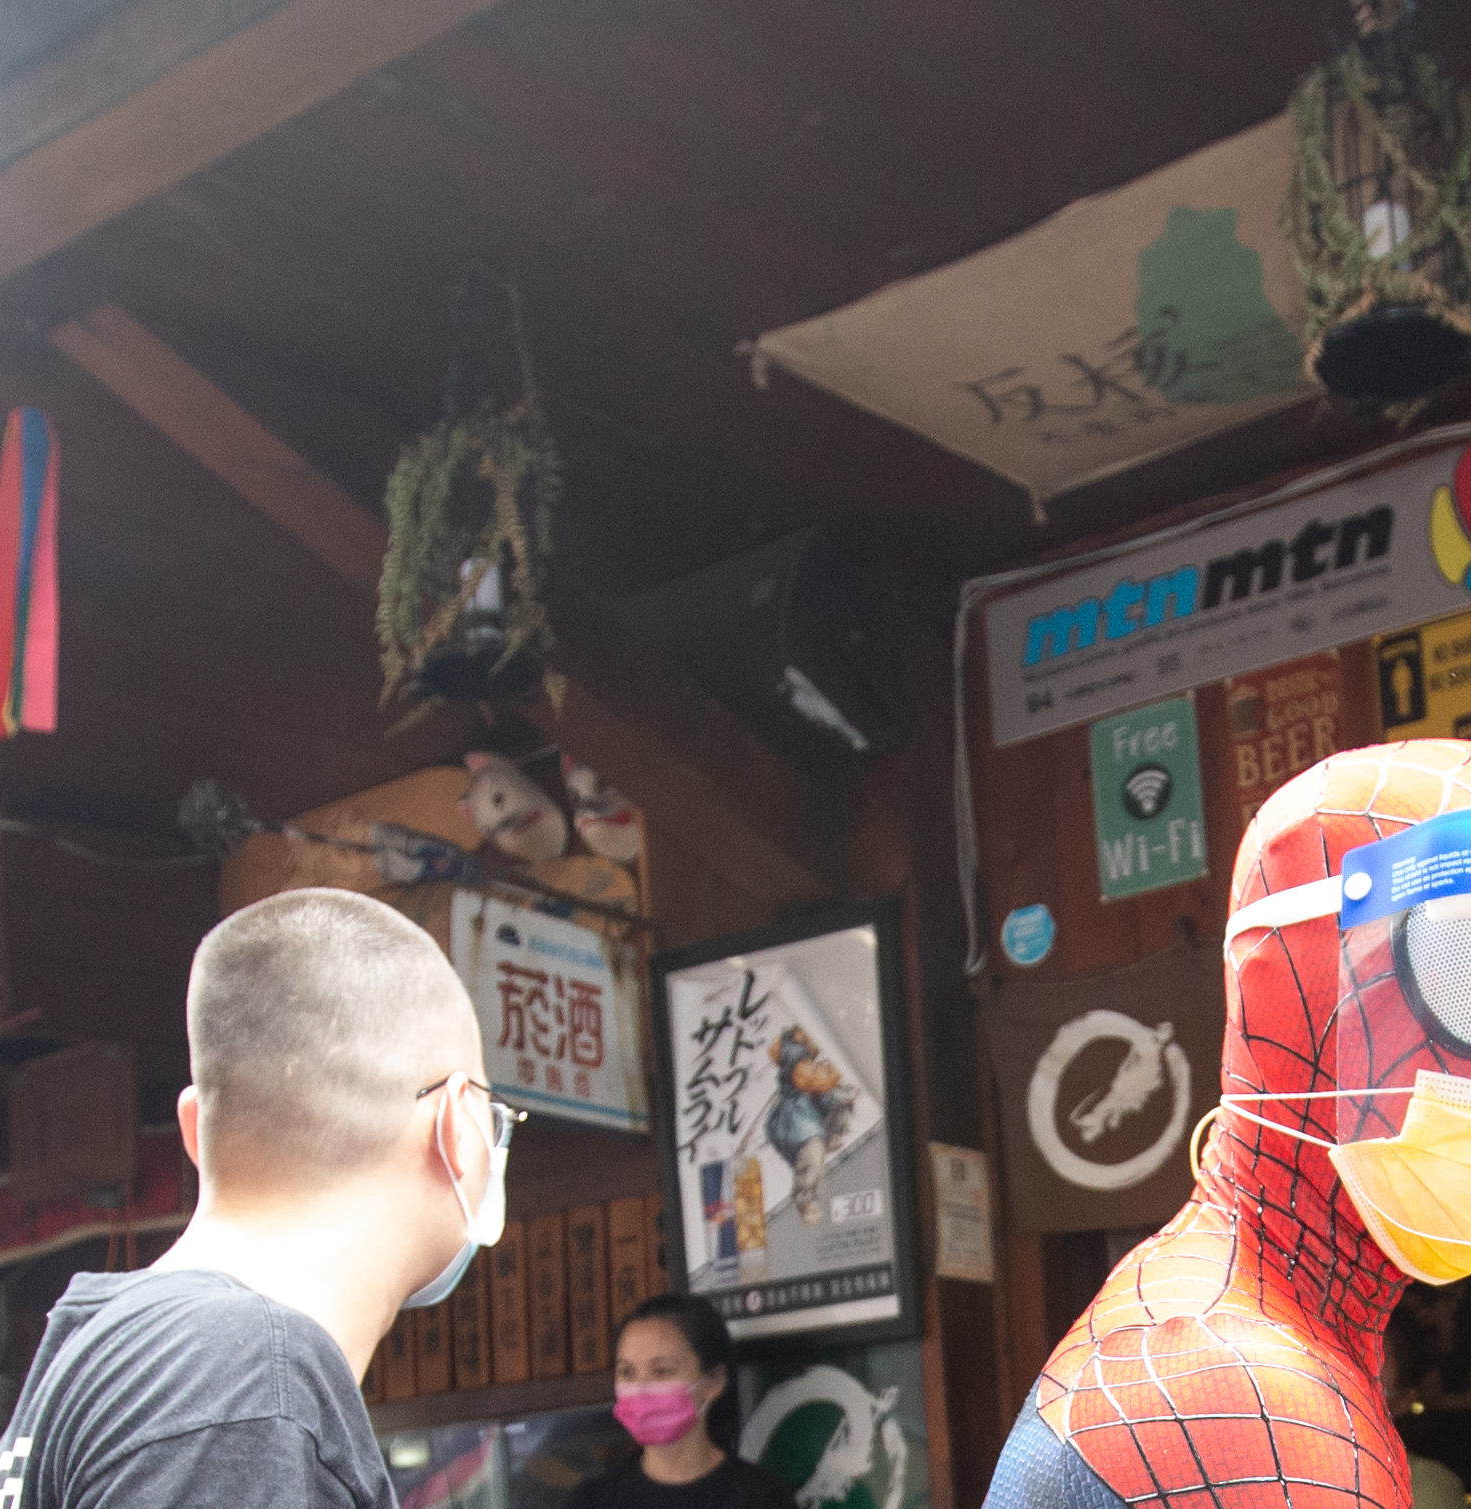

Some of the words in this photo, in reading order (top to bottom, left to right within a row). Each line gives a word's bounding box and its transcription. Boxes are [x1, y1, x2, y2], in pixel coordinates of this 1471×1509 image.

[1112, 721, 1177, 762] Free
[1235, 715, 1338, 788] BEER
[1101, 818, 1203, 880] Wi-Fi
[1431, 867, 1463, 880] protection
[1439, 850, 1460, 861] liquids
[1440, 858, 1462, 868] impact
[495, 959, 605, 1071] 菸酒
[711, 968, 770, 1135] レッドブル
[679, 1005, 735, 1163] サムライ
